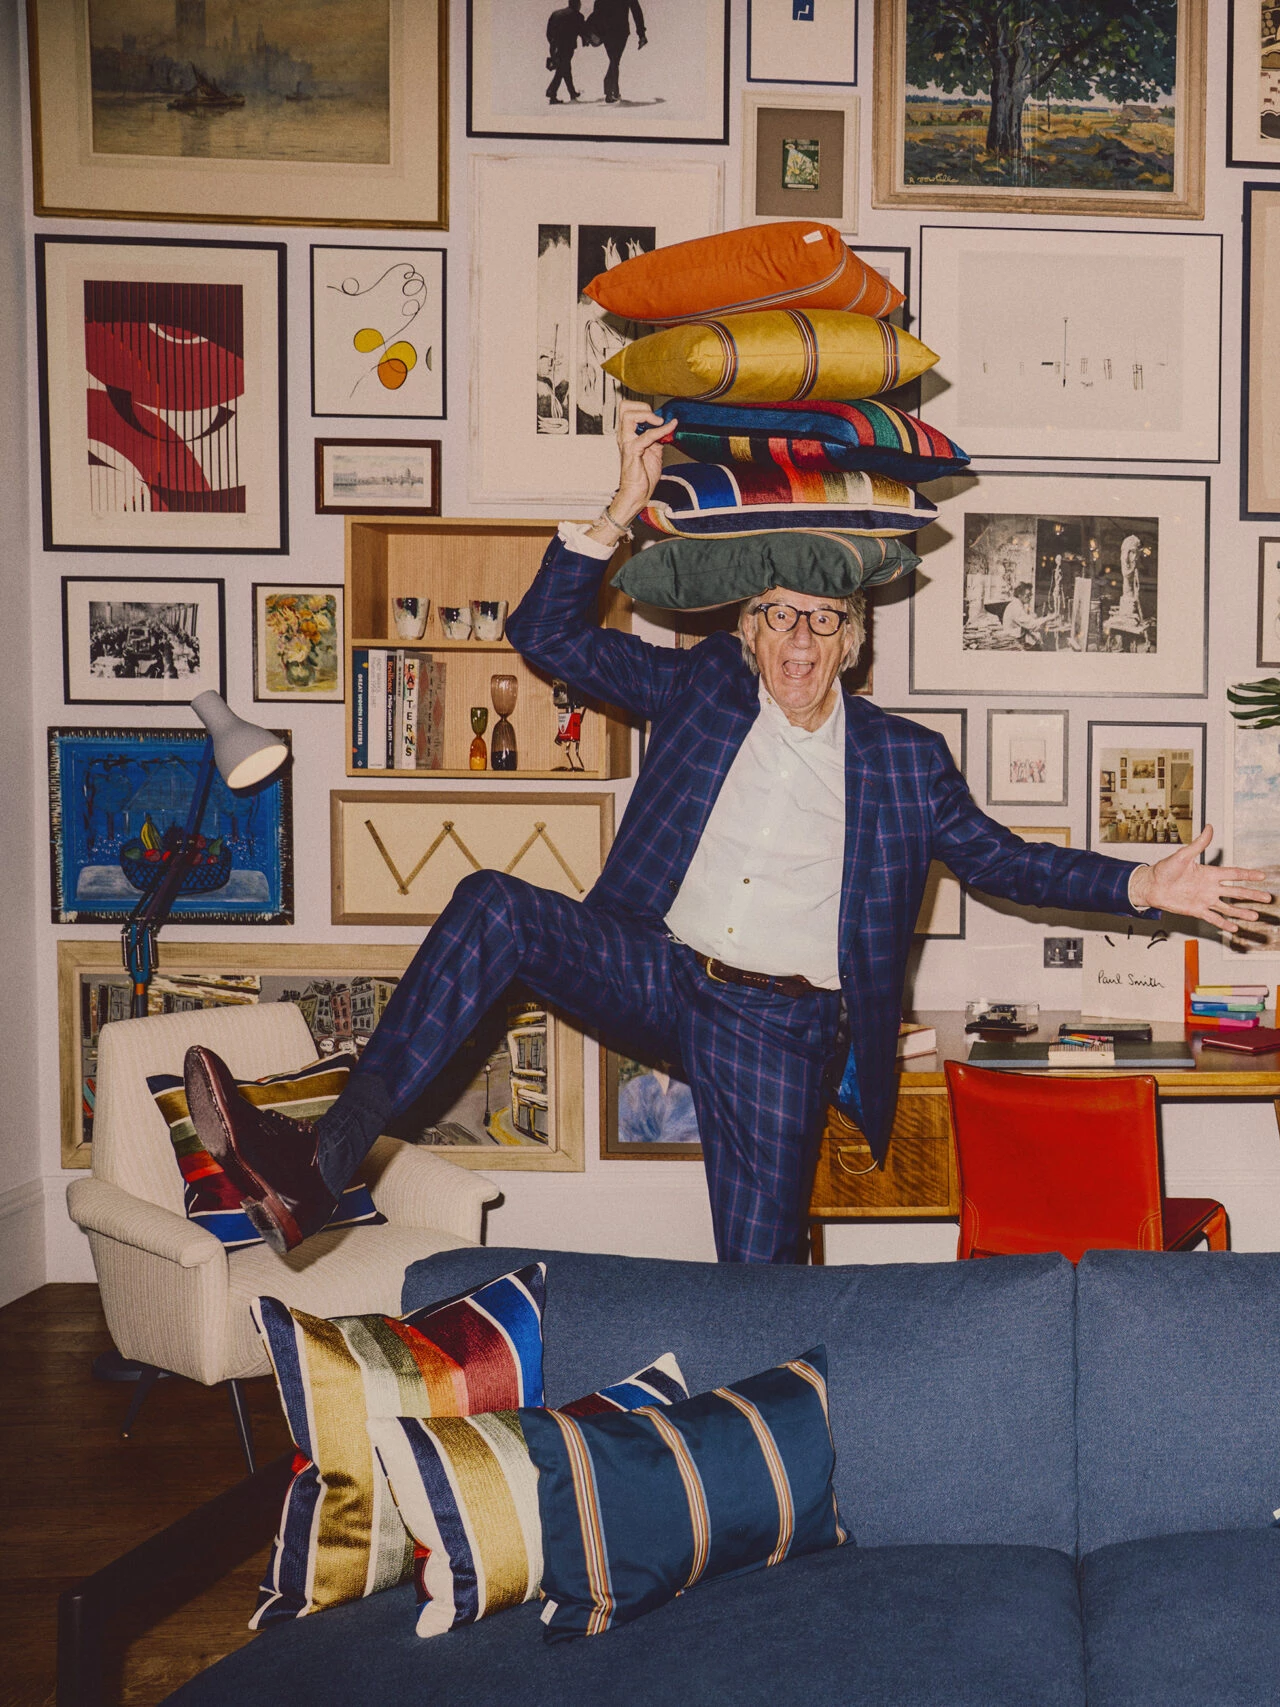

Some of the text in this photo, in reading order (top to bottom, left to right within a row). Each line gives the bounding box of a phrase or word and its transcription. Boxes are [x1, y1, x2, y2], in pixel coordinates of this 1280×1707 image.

[404, 663, 416, 757] PATTERNS
[1097, 969, 1165, 988] Paul Smith
